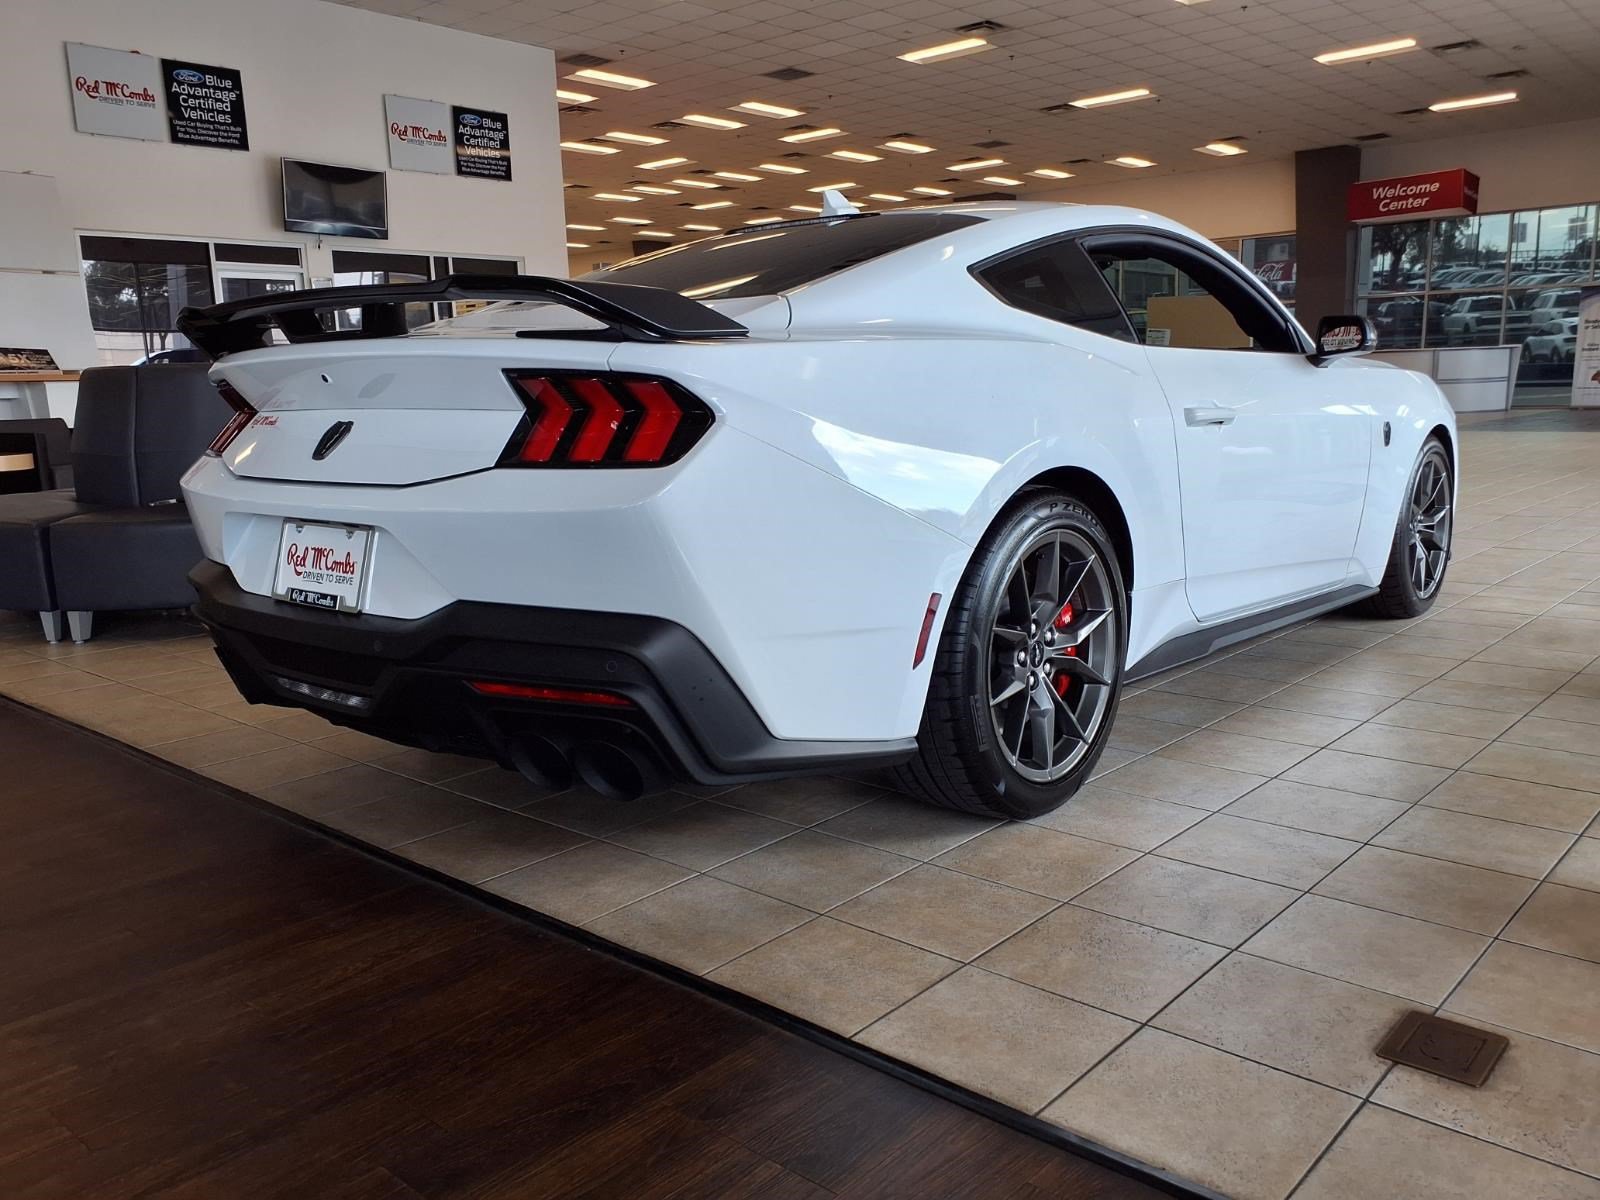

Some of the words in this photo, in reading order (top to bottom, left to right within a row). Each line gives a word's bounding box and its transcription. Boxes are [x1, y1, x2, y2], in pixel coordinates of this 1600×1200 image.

[176, 70, 201, 82] Ford
[205, 75, 232, 88] Blue
[76, 76, 101, 99] Red
[101, 81, 155, 102] McCombs
[98, 95, 124, 105] DRIVEN
[136, 101, 156, 109] SERVE
[180, 95, 231, 112] Certified
[181, 107, 232, 123] Vehicles
[197, 122, 214, 130] Buying
[391, 122, 408, 141] Red
[409, 126, 447, 142] McCombs
[482, 118, 502, 130] Blue
[190, 134, 217, 142] Advantage
[463, 135, 500, 149] Certified
[465, 145, 500, 159] Vehicles
[1372, 182, 1440, 200] Welcome
[1379, 197, 1430, 212] Center
[1049, 502, 1058, 513] P
[1062, 502, 1099, 528] ZERO
[287, 543, 309, 576] Red
[310, 546, 356, 575] McCombs
[303, 570, 324, 582] DRIVEN
[325, 573, 334, 583] TO
[334, 575, 354, 586] SERVE
[292, 589, 306, 603] Red
[306, 592, 334, 607] McCombs
